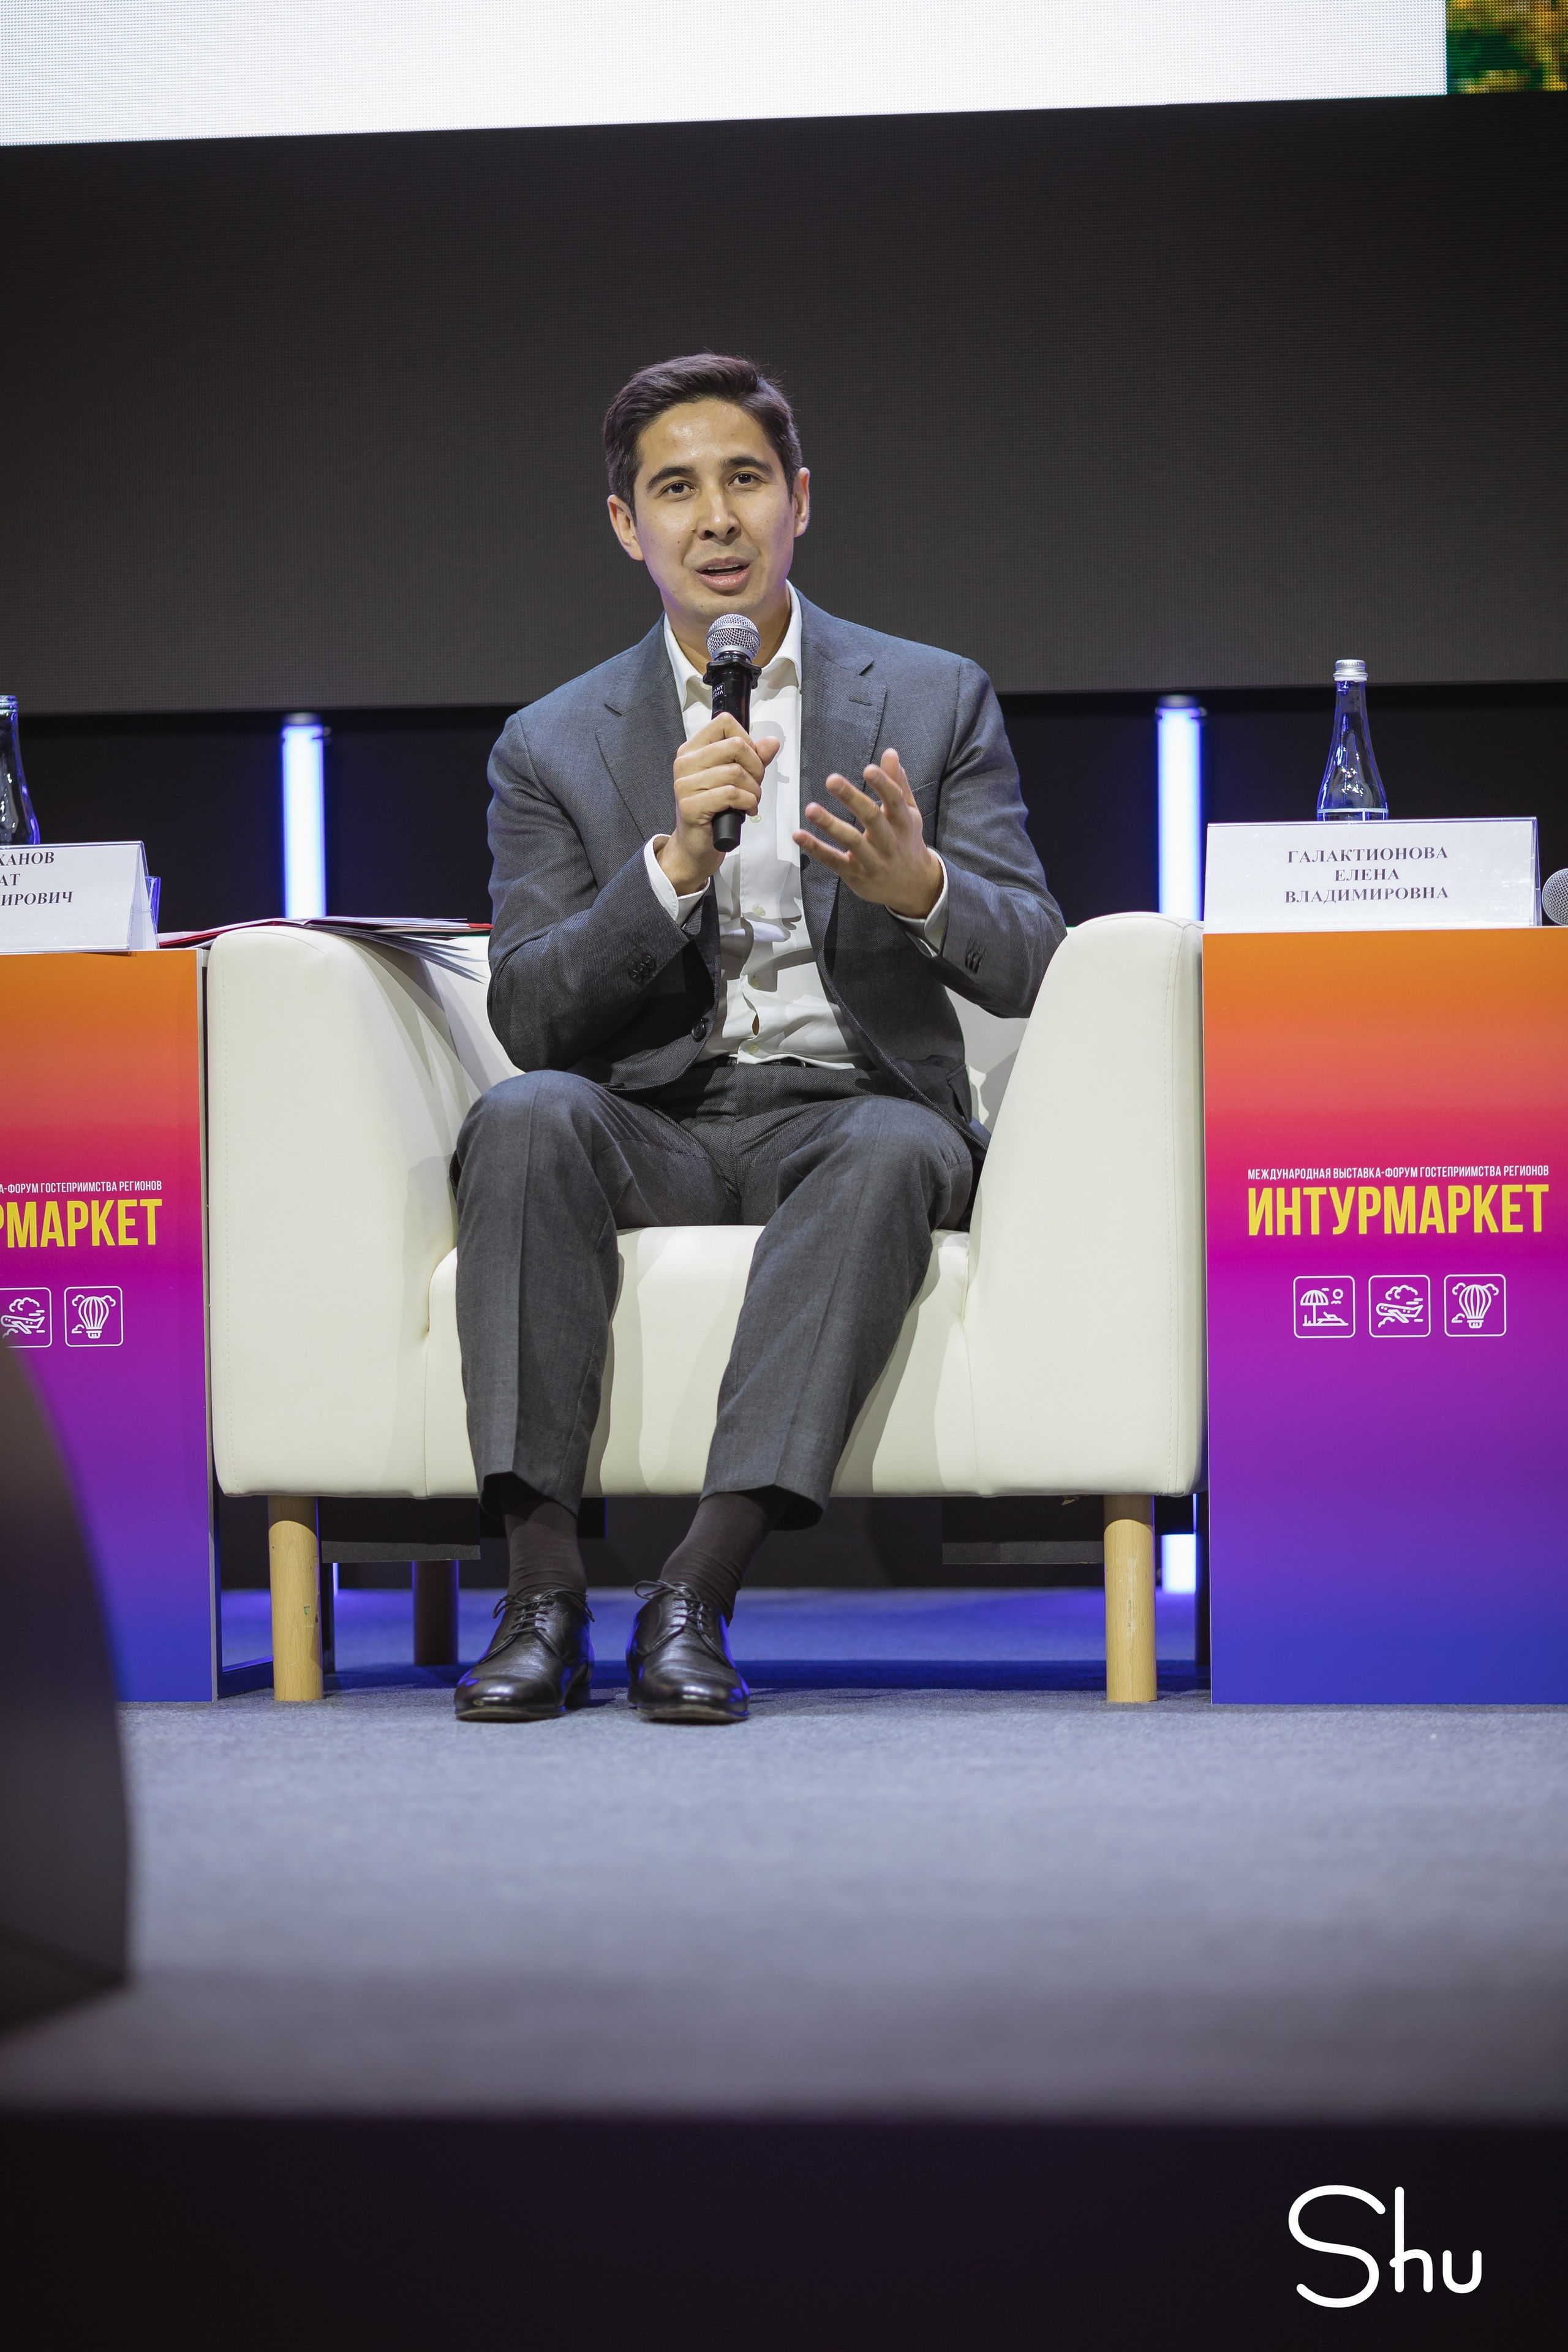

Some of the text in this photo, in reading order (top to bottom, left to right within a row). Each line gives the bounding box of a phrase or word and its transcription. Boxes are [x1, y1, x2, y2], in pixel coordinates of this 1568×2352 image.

[1287, 846, 1449, 863] ГАЛАКТИОНОВА
[0, 873, 20, 886] АТ
[1334, 869, 1400, 881] ЕЛЕНА
[1, 891, 73, 906] ИРОВИЧ
[1285, 887, 1449, 905] ВЛАДИМИРОВНА
[1248, 1164, 1550, 1181] МЕЖДУНАРОДНАЯ ВЫСТАВКА-ФОРУМ ГОСТЕПРИИМСТВА РЕГИОНОВ
[40, 1181, 118, 1193] ГОСТЕПРИИМСТВА
[119, 1180, 162, 1192] РЕГИОНОВ
[1248, 1183, 1550, 1236] ИНТУРМАРКЕТ
[0, 1198, 163, 1248] МАРКЕТ
